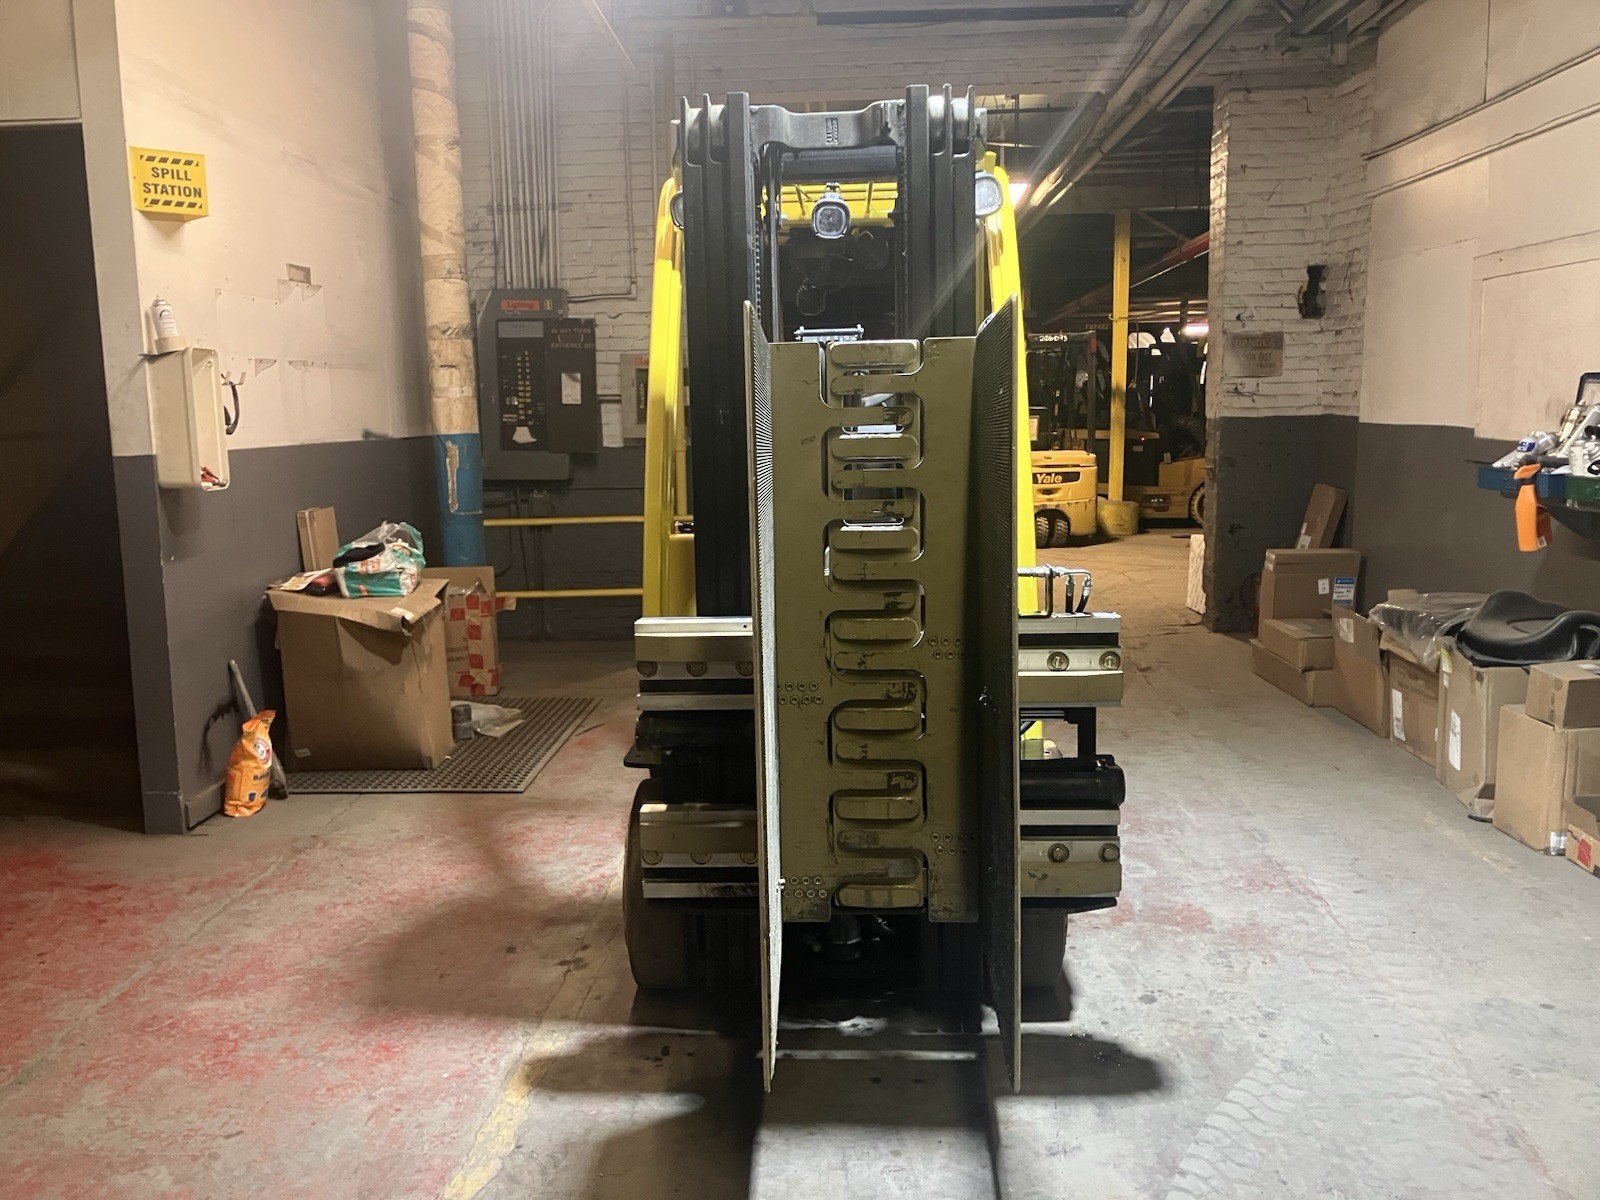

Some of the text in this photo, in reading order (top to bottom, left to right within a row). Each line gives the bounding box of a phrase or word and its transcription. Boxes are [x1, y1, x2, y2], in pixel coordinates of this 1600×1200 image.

[151, 166, 192, 181] SPILL
[142, 182, 202, 198] STATION
[506, 300, 534, 310] Lighting
[1235, 339, 1275, 347] DANGER
[1036, 473, 1063, 484] Yale
